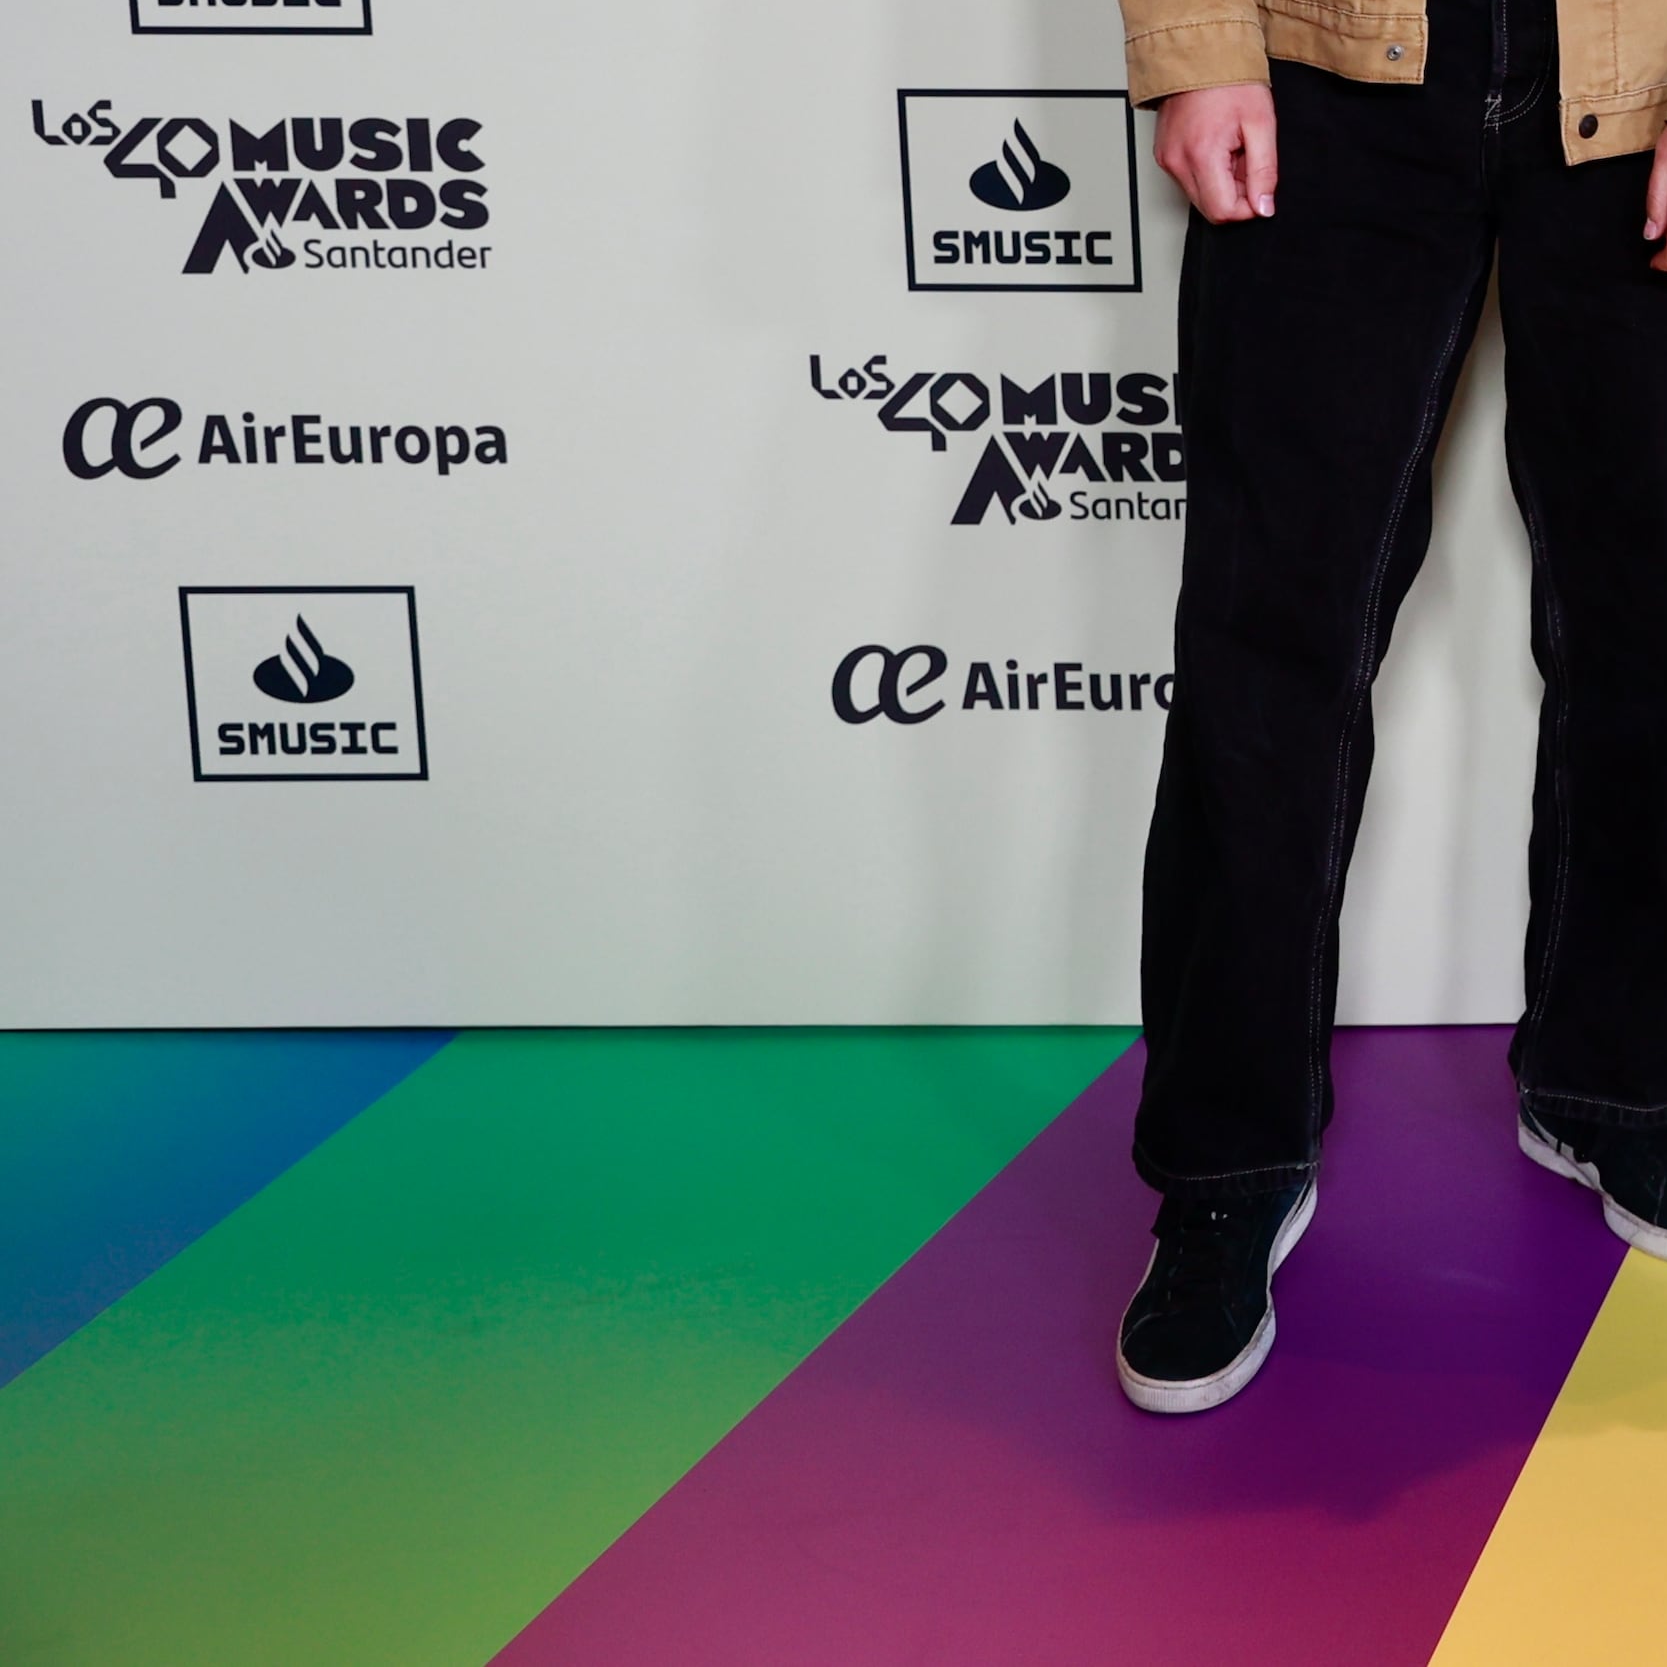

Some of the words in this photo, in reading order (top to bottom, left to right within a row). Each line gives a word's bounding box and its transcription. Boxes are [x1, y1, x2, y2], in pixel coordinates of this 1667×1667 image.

[103, 117, 220, 199] 40
[229, 117, 486, 172] MUSIC
[182, 177, 489, 274] AWARDS
[304, 239, 492, 269] Santander
[933, 230, 1113, 265] SMUSIC
[878, 372, 990, 452] 40
[1000, 372, 1181, 426] MUS
[198, 411, 508, 475] AirEuropa
[950, 432, 1187, 525] AWARD
[1070, 491, 1187, 520] Santan
[962, 660, 1174, 711] AirEuro
[217, 721, 399, 755] SMUSIC
